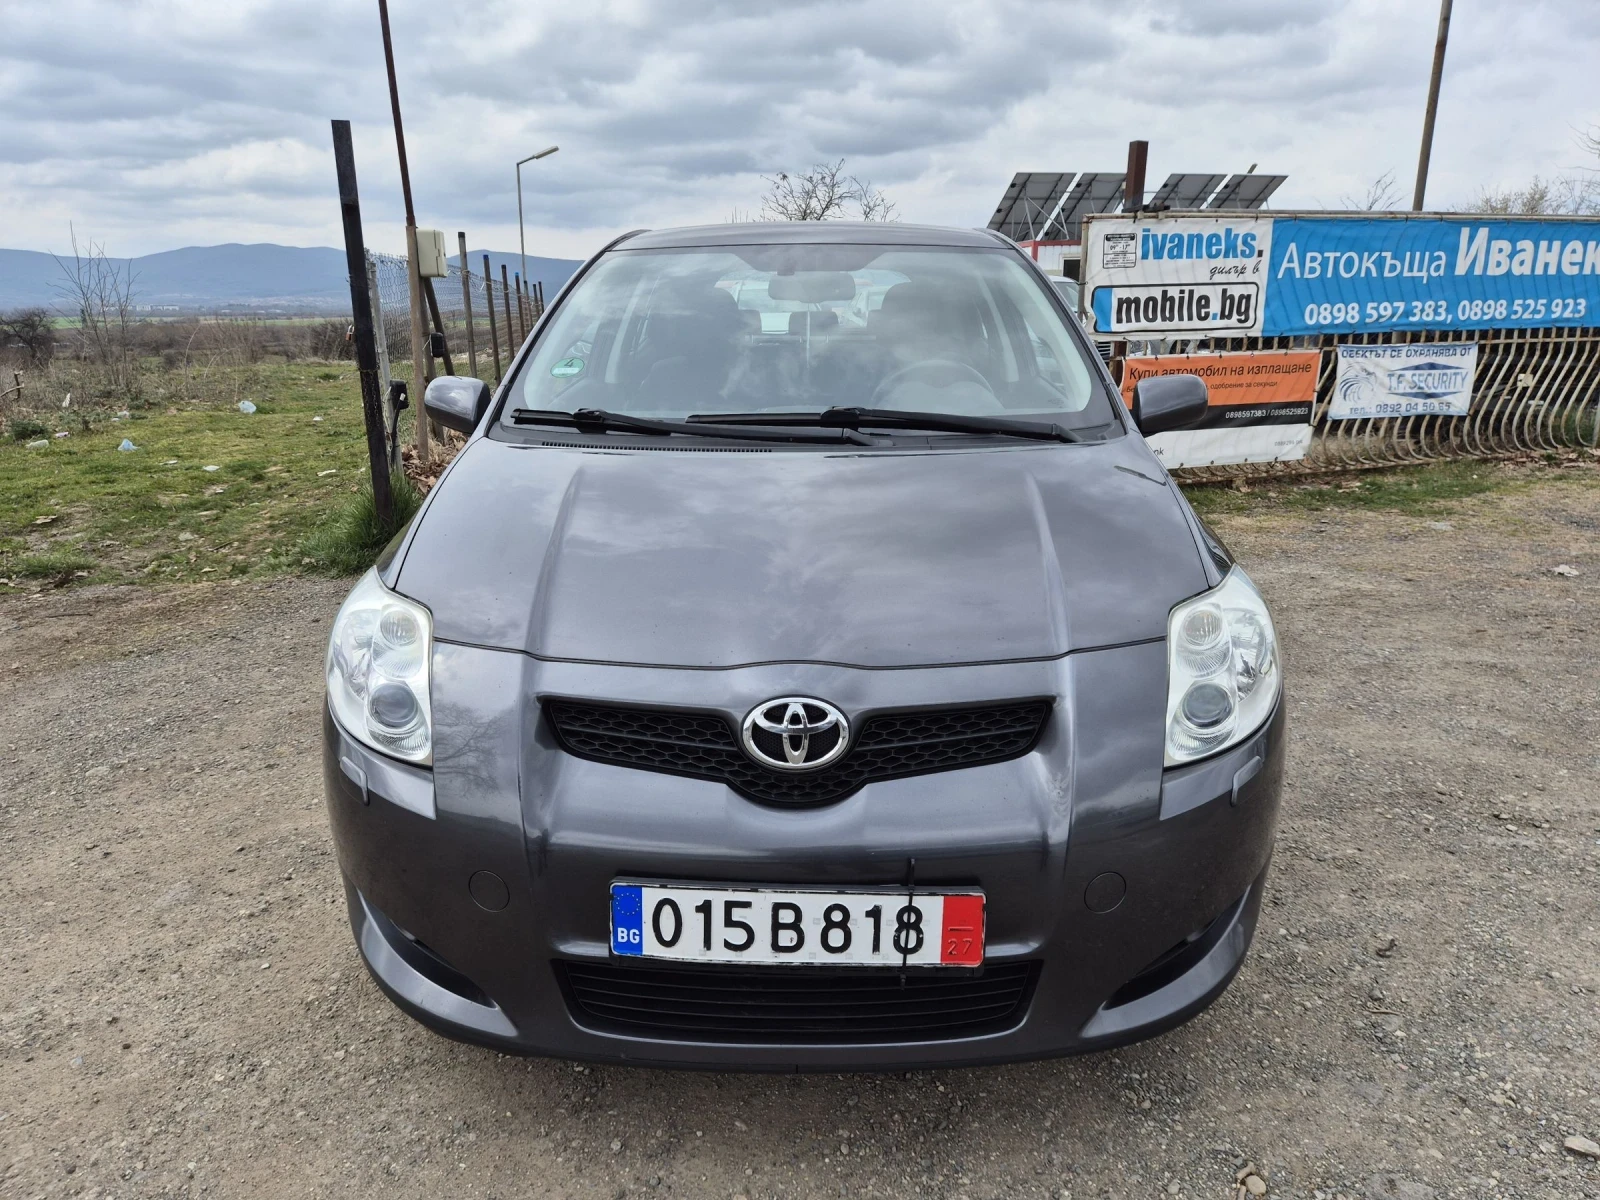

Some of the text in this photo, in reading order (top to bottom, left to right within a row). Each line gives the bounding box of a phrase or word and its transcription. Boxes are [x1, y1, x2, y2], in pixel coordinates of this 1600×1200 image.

[1277, 242, 1447, 284] Автокъща
[1209, 265, 1247, 280] дилър
[1116, 288, 1252, 324] mobile.bg
[1304, 298, 1586, 325] 0898 597 383, 0898 525 923
[1390, 349, 1402, 358] СЕ
[1406, 348, 1457, 358] ОХРАНЯВА
[1460, 347, 1472, 357] ОТ
[564, 358, 575, 368] 4
[1129, 363, 1312, 380] Купи автомобил на изплащане
[1410, 371, 1469, 391] SECURITY
[1375, 404, 1401, 413] 0892
[1405, 403, 1417, 413] 04
[617, 927, 640, 944] BG
[947, 938, 973, 956] 27
